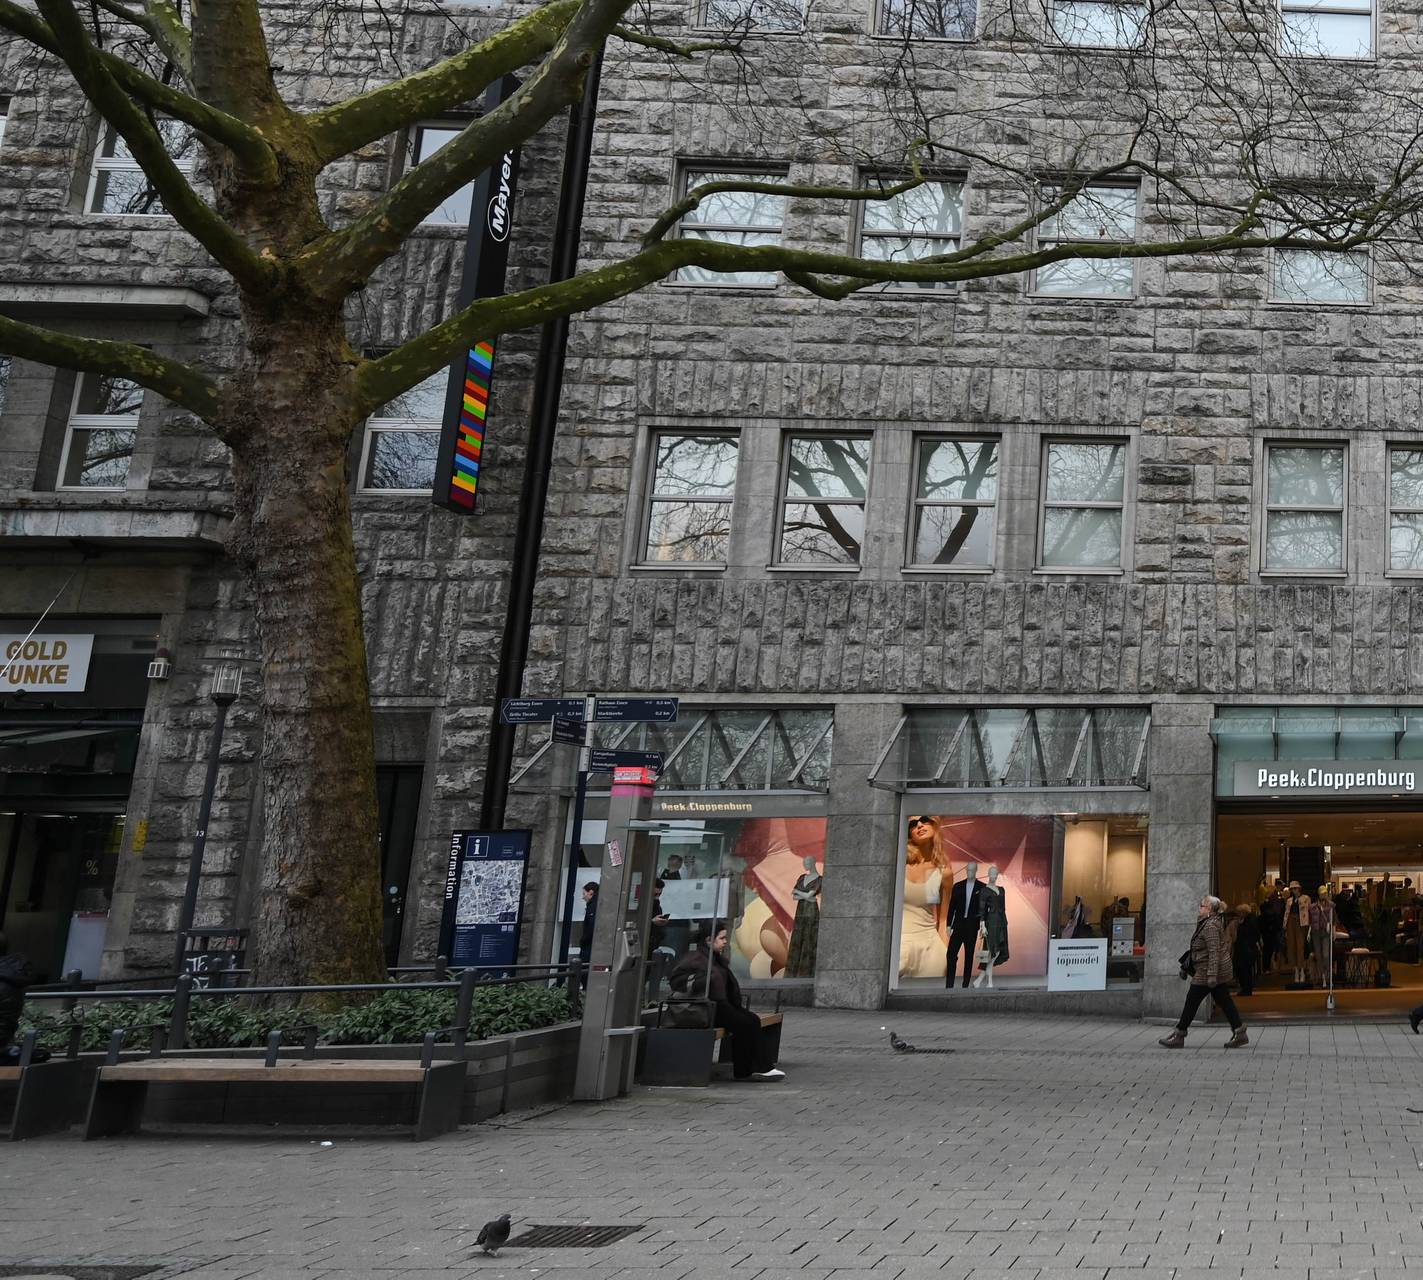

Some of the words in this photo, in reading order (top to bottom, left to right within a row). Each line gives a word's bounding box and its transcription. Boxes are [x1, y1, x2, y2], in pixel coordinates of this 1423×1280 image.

[492, 148, 514, 233] Mayer
[6, 640, 68, 660] GOLD
[445, 833, 463, 899] Information
